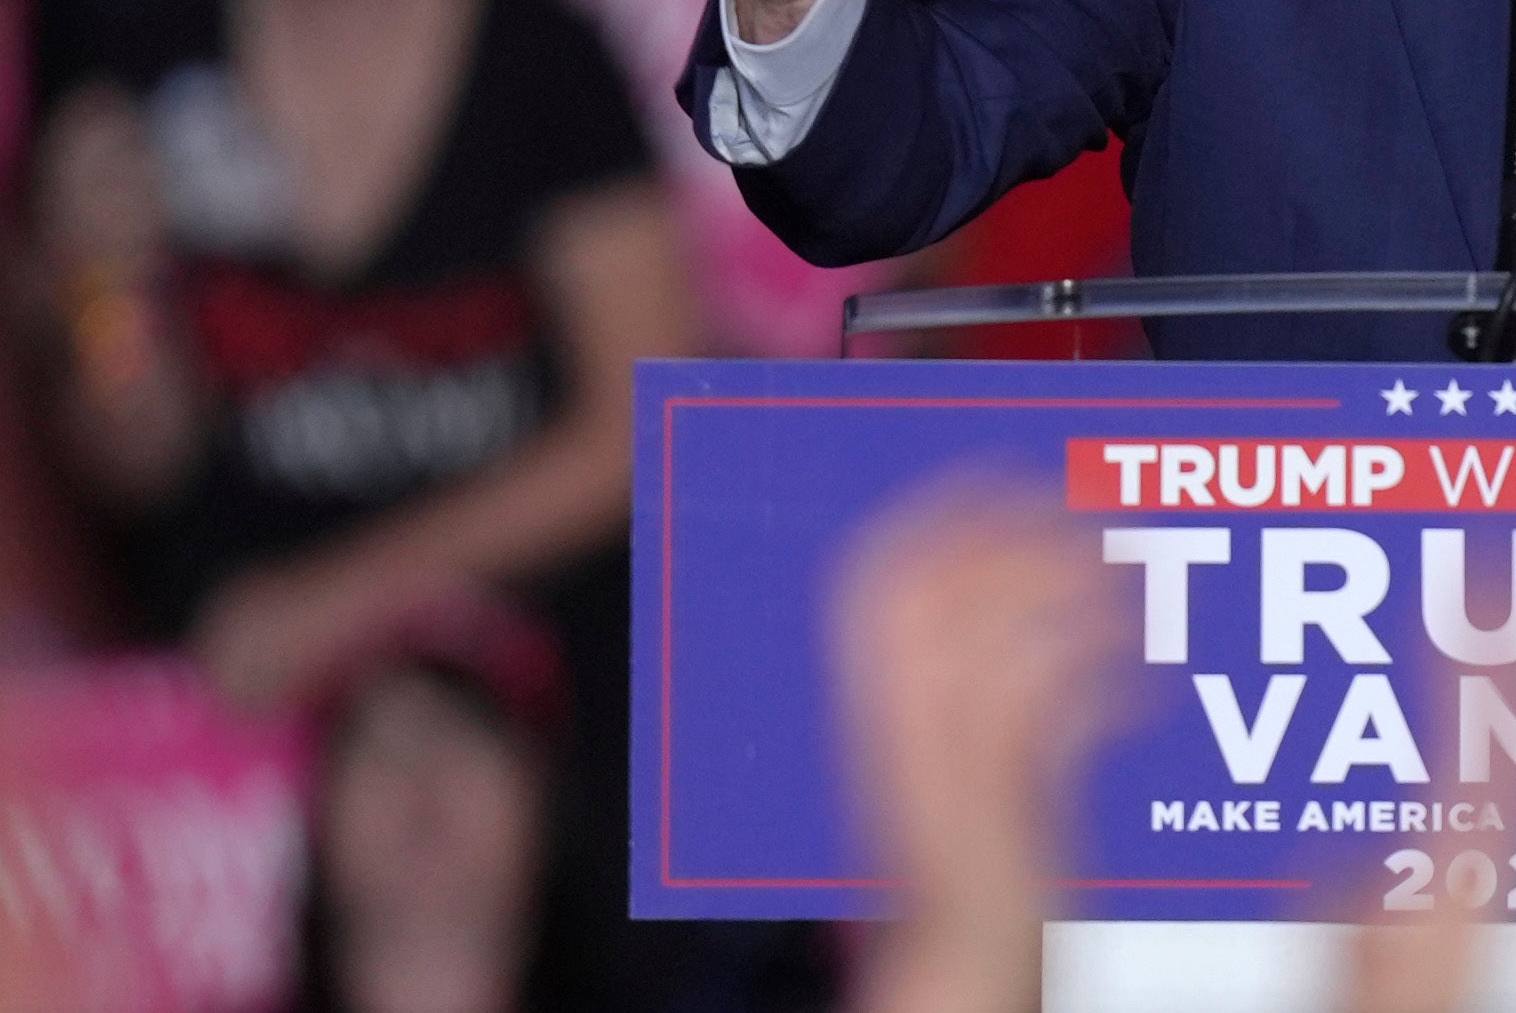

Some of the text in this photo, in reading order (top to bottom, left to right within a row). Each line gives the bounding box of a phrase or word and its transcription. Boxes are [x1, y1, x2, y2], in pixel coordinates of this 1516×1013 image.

[1104, 445, 1404, 507] TRUMP
[1151, 801, 1281, 832] MAKE
[1297, 801, 1505, 833] AMERICA
